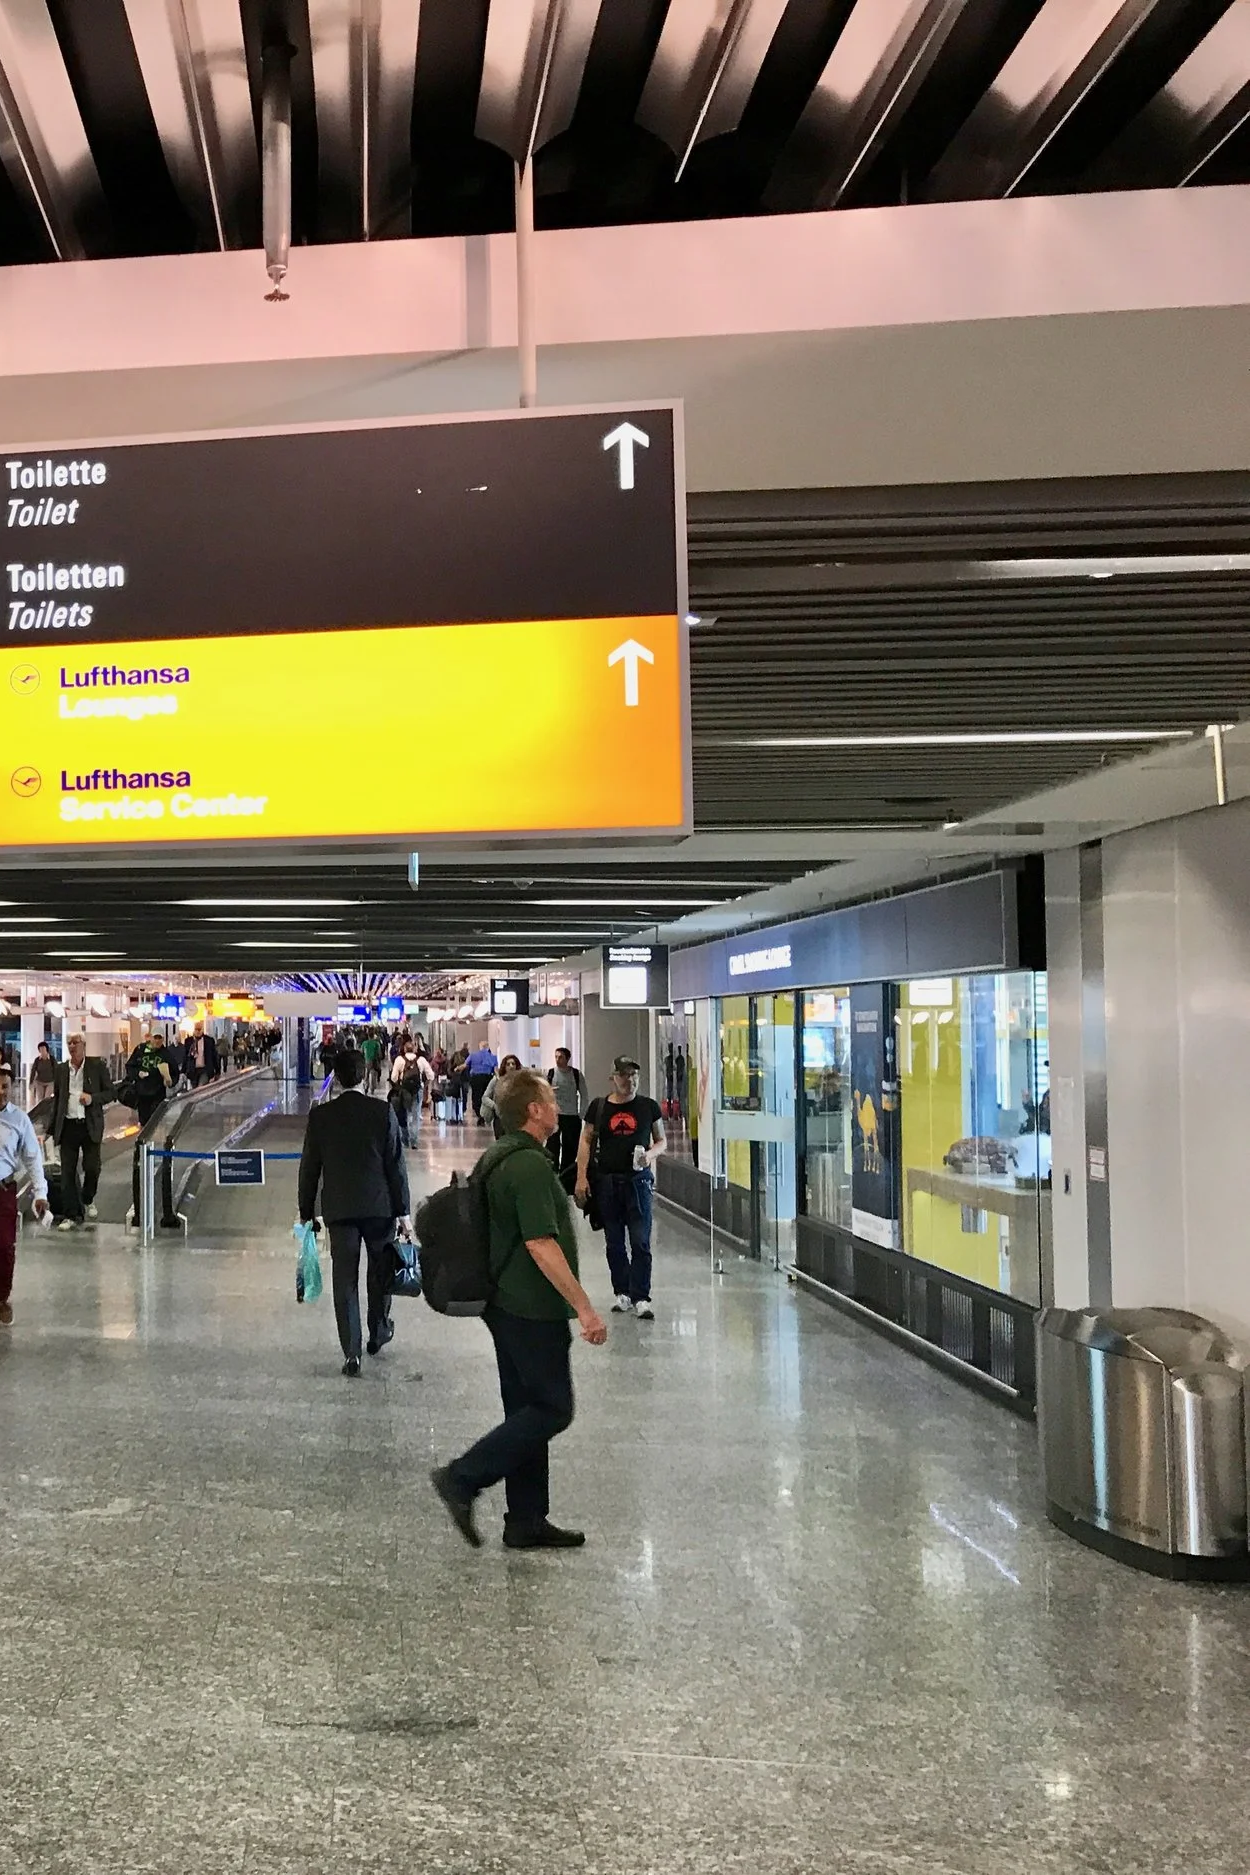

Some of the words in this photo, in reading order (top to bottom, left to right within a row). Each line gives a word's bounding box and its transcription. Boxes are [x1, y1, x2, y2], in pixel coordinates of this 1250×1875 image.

[5, 459, 107, 490] Toilette
[7, 497, 80, 527] Toilet
[6, 562, 125, 592] Toiletten
[8, 600, 94, 630] Toilets
[60, 665, 190, 688] Lufthansa
[58, 694, 179, 721] Lounges
[61, 768, 191, 791] Lufthansa
[59, 795, 165, 822] Service
[170, 792, 269, 818] Center
